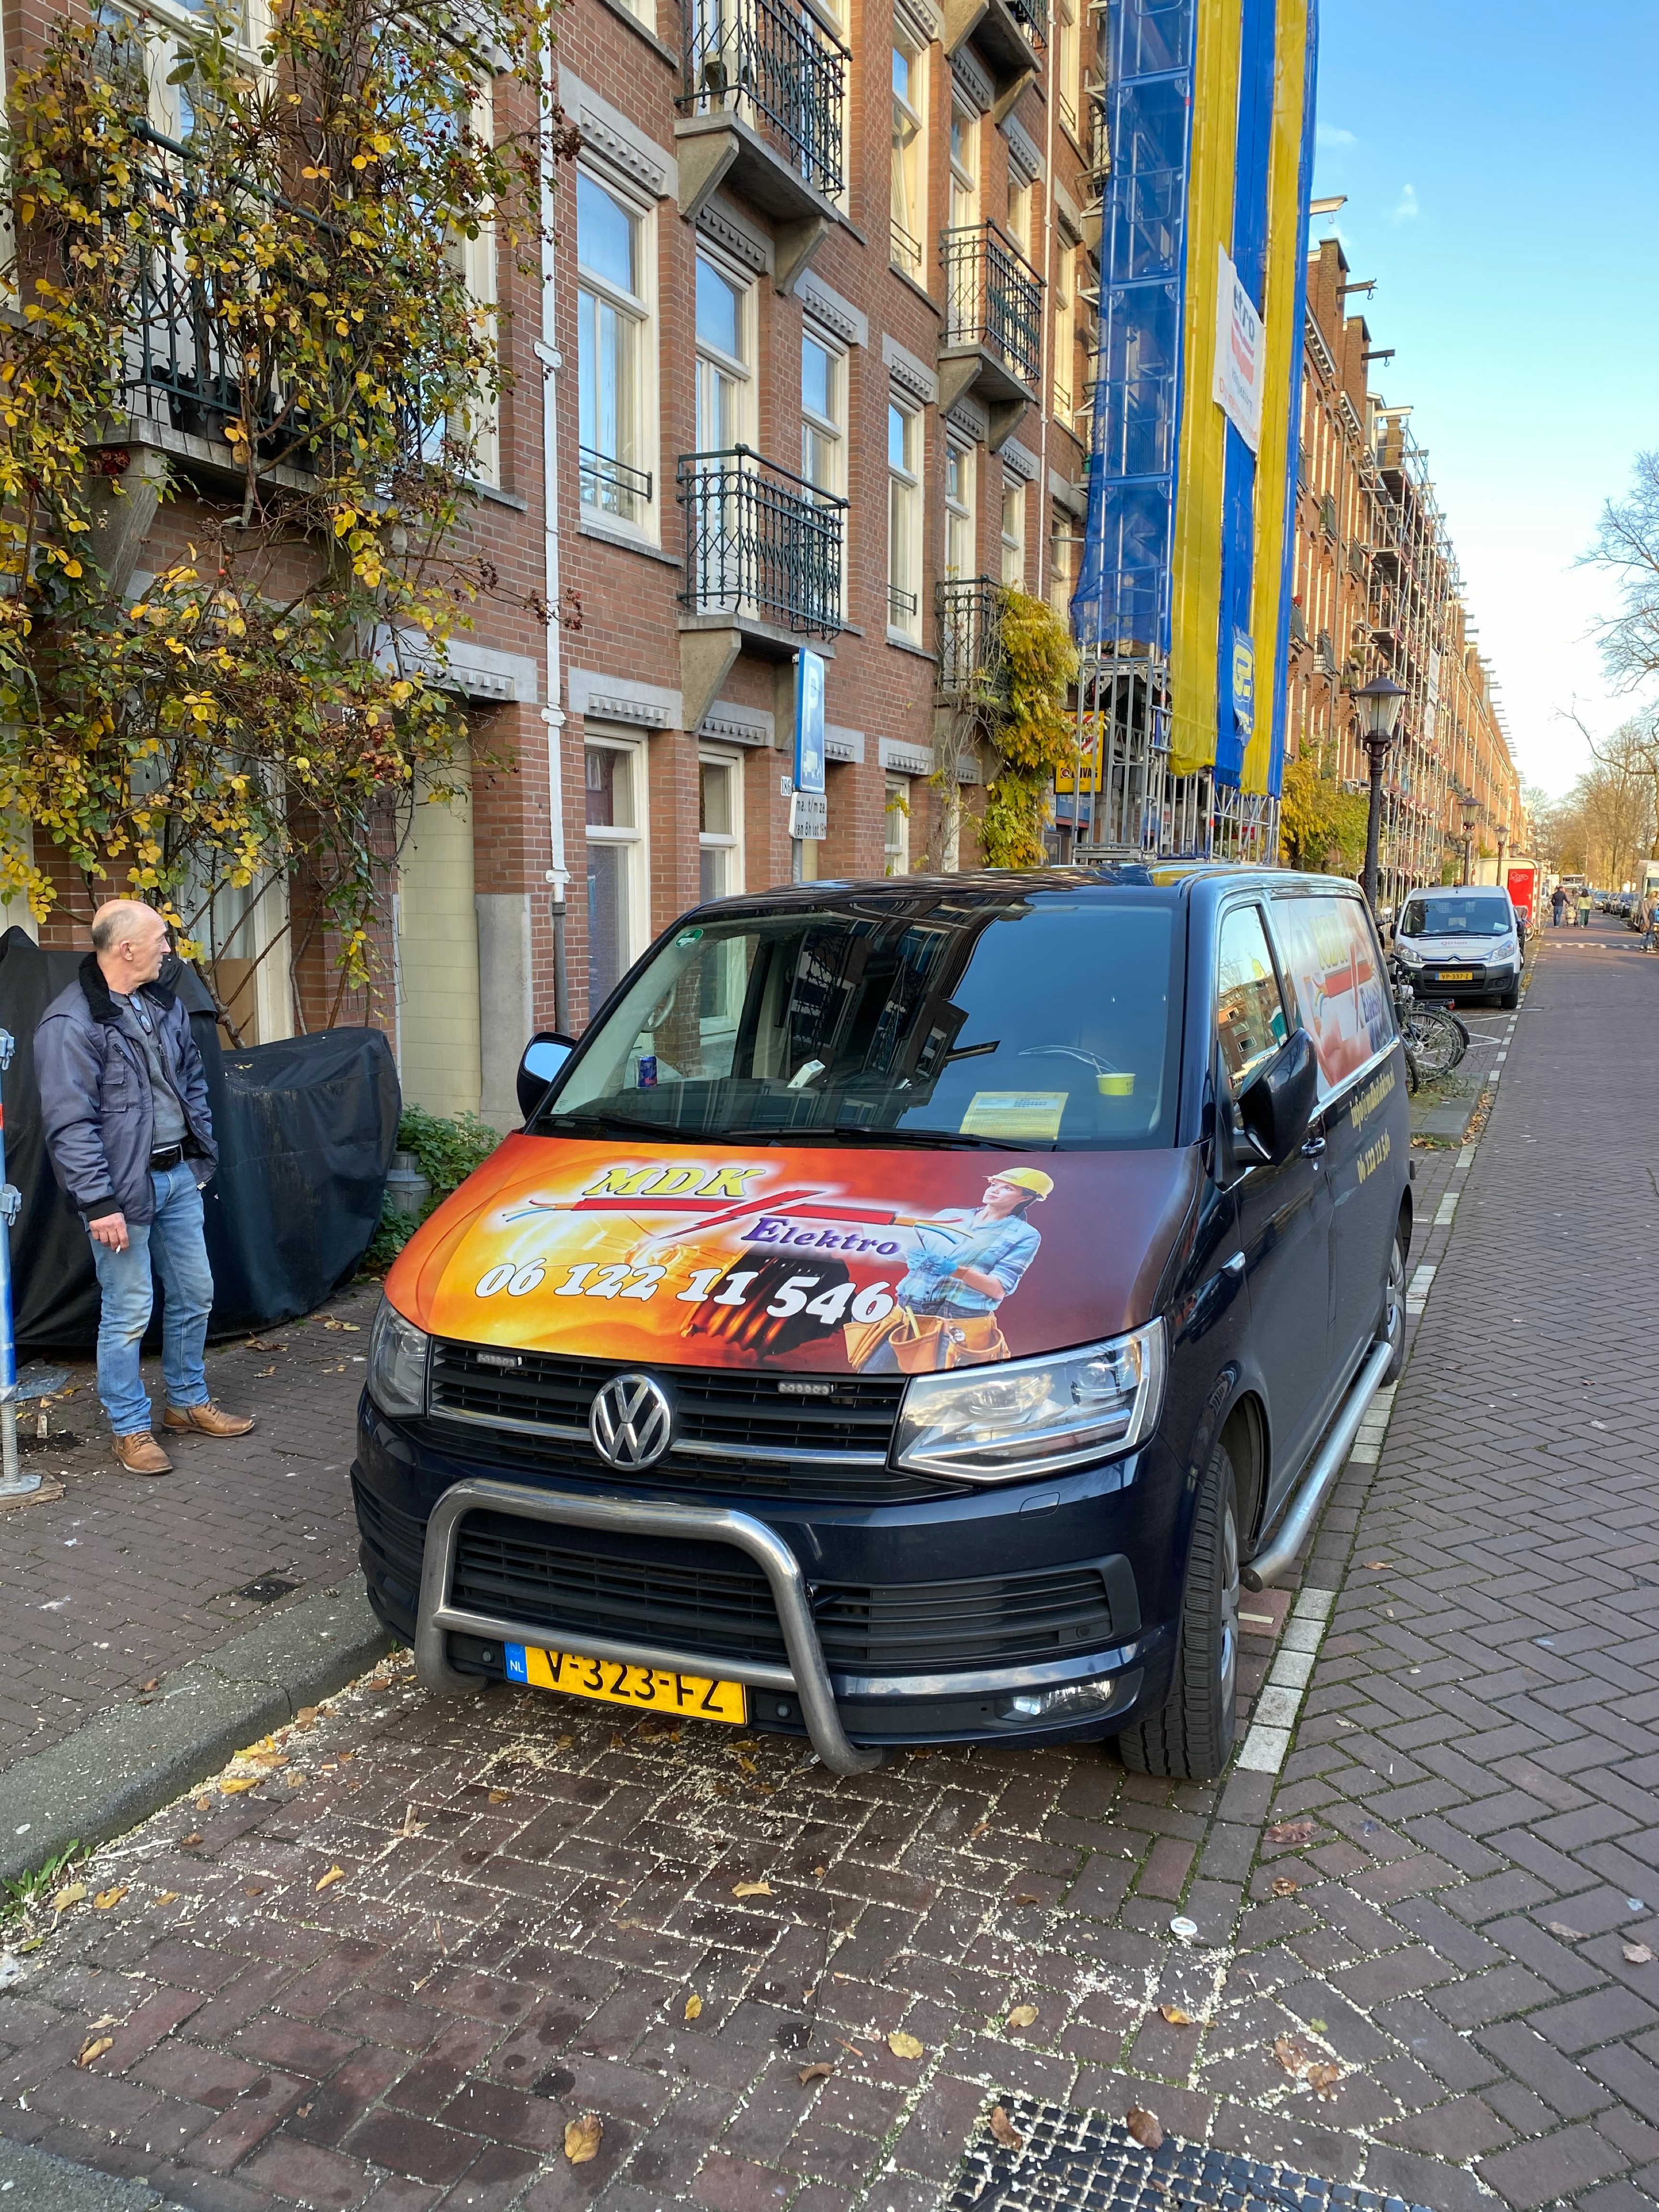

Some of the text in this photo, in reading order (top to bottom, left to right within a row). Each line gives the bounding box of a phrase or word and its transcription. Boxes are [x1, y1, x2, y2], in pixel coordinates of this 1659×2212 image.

[807, 665, 819, 732] P
[781, 779, 791, 794] 186
[808, 797, 818, 813] t/m
[805, 821, 811, 836] 8h
[582, 1167, 766, 1197] MDK
[741, 1217, 901, 1255] Elektro
[475, 1258, 893, 1324] 06 122 11 546
[510, 1660, 524, 1674] NL
